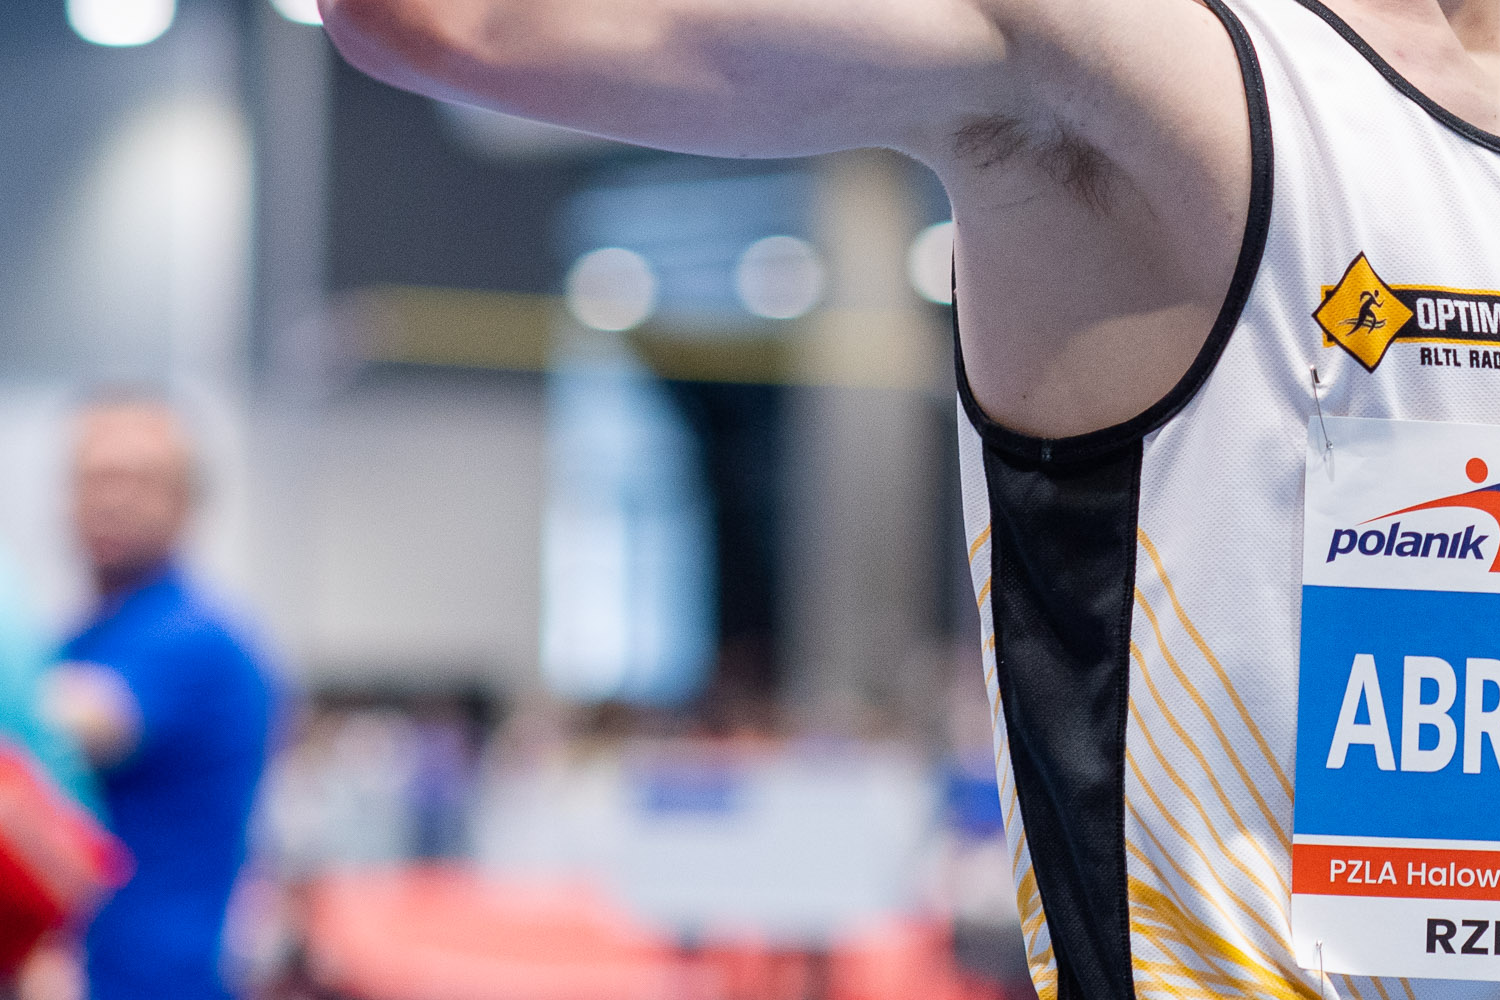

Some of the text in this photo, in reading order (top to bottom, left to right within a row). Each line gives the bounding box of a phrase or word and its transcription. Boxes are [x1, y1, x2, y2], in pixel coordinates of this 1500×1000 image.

[1420, 347, 1461, 367] RLTL
[1326, 522, 1489, 563] polanik
[1330, 859, 1397, 885] PZLA
